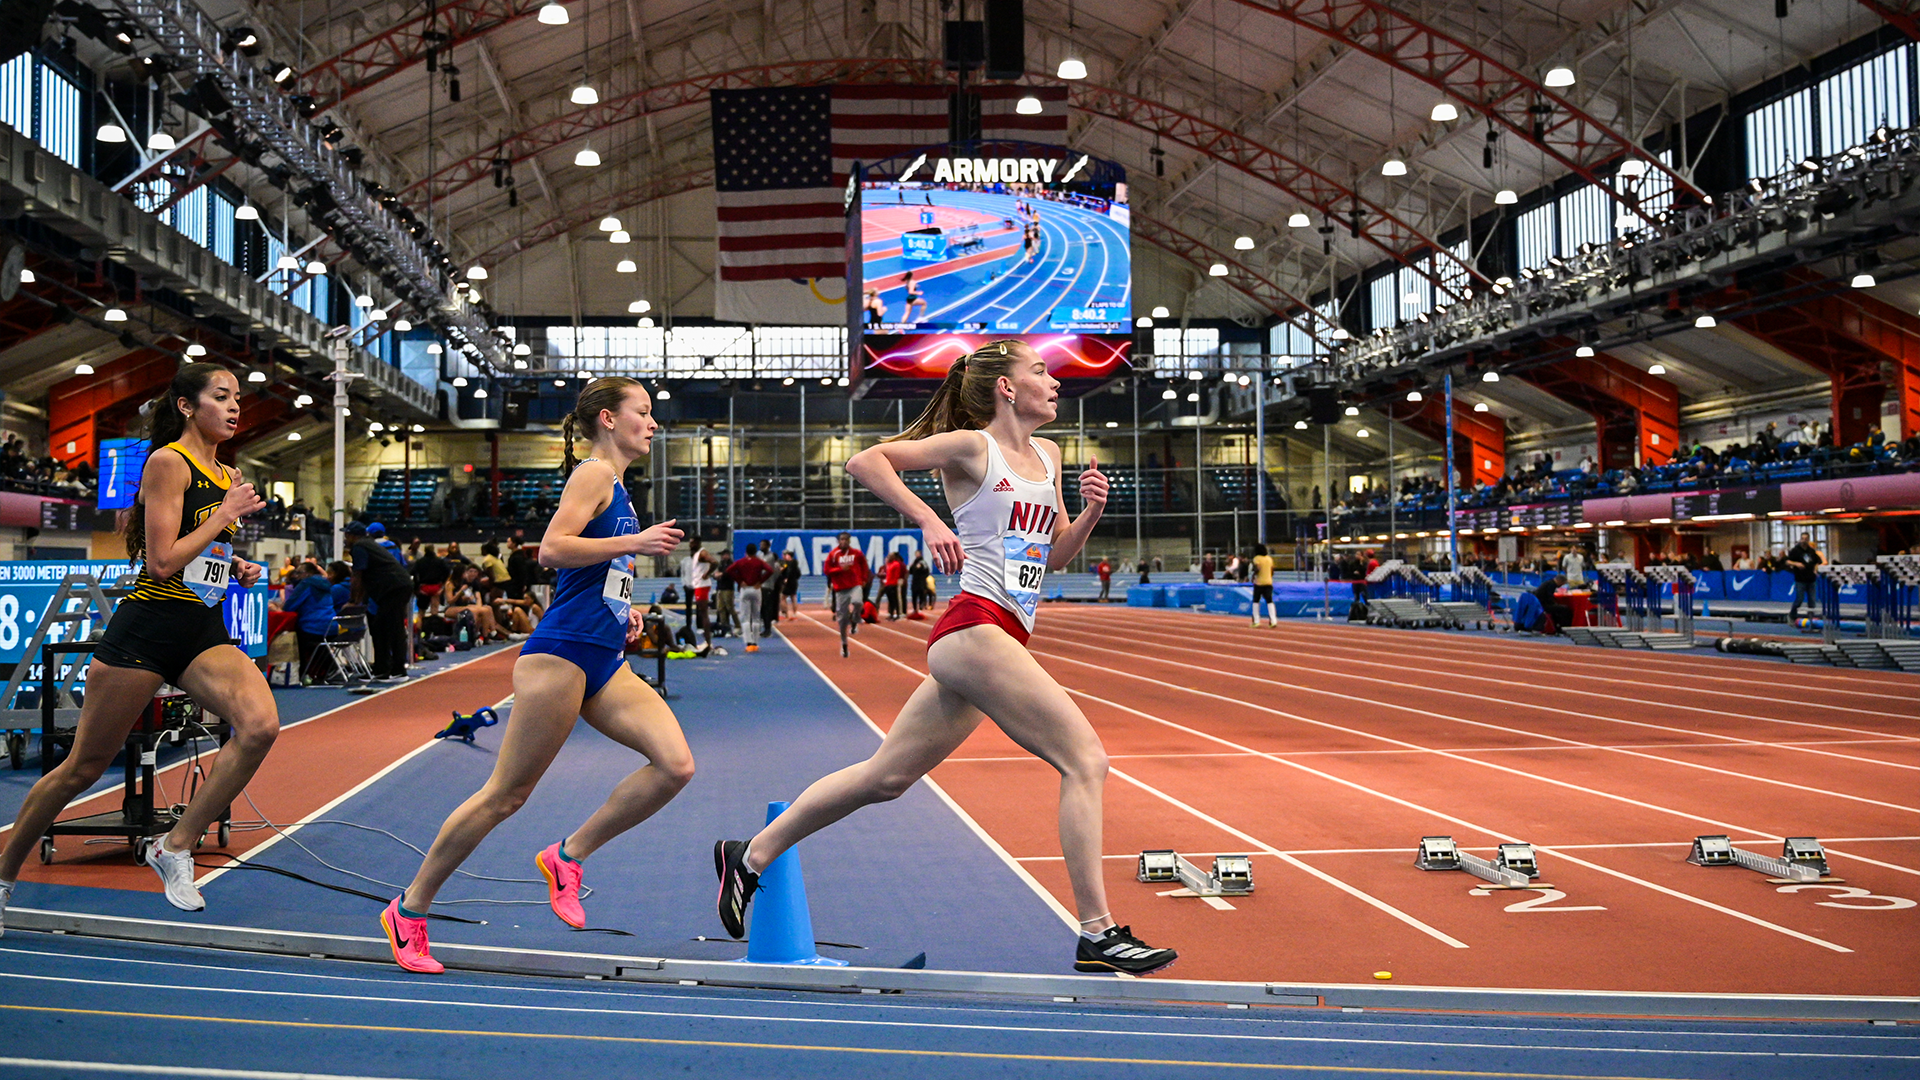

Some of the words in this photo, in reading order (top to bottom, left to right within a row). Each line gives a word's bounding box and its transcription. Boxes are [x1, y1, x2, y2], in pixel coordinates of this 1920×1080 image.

[933, 158, 1057, 183] ARMORY
[1072, 309, 1106, 320] 8:40.2
[107, 449, 118, 498] 2
[12, 566, 36, 580] 3000
[36, 565, 67, 580] METER
[203, 561, 225, 584] 791
[1019, 564, 1042, 590] 623
[231, 592, 264, 646] 8:40.2
[1468, 888, 1608, 913] 2
[1775, 884, 1917, 910] 3
